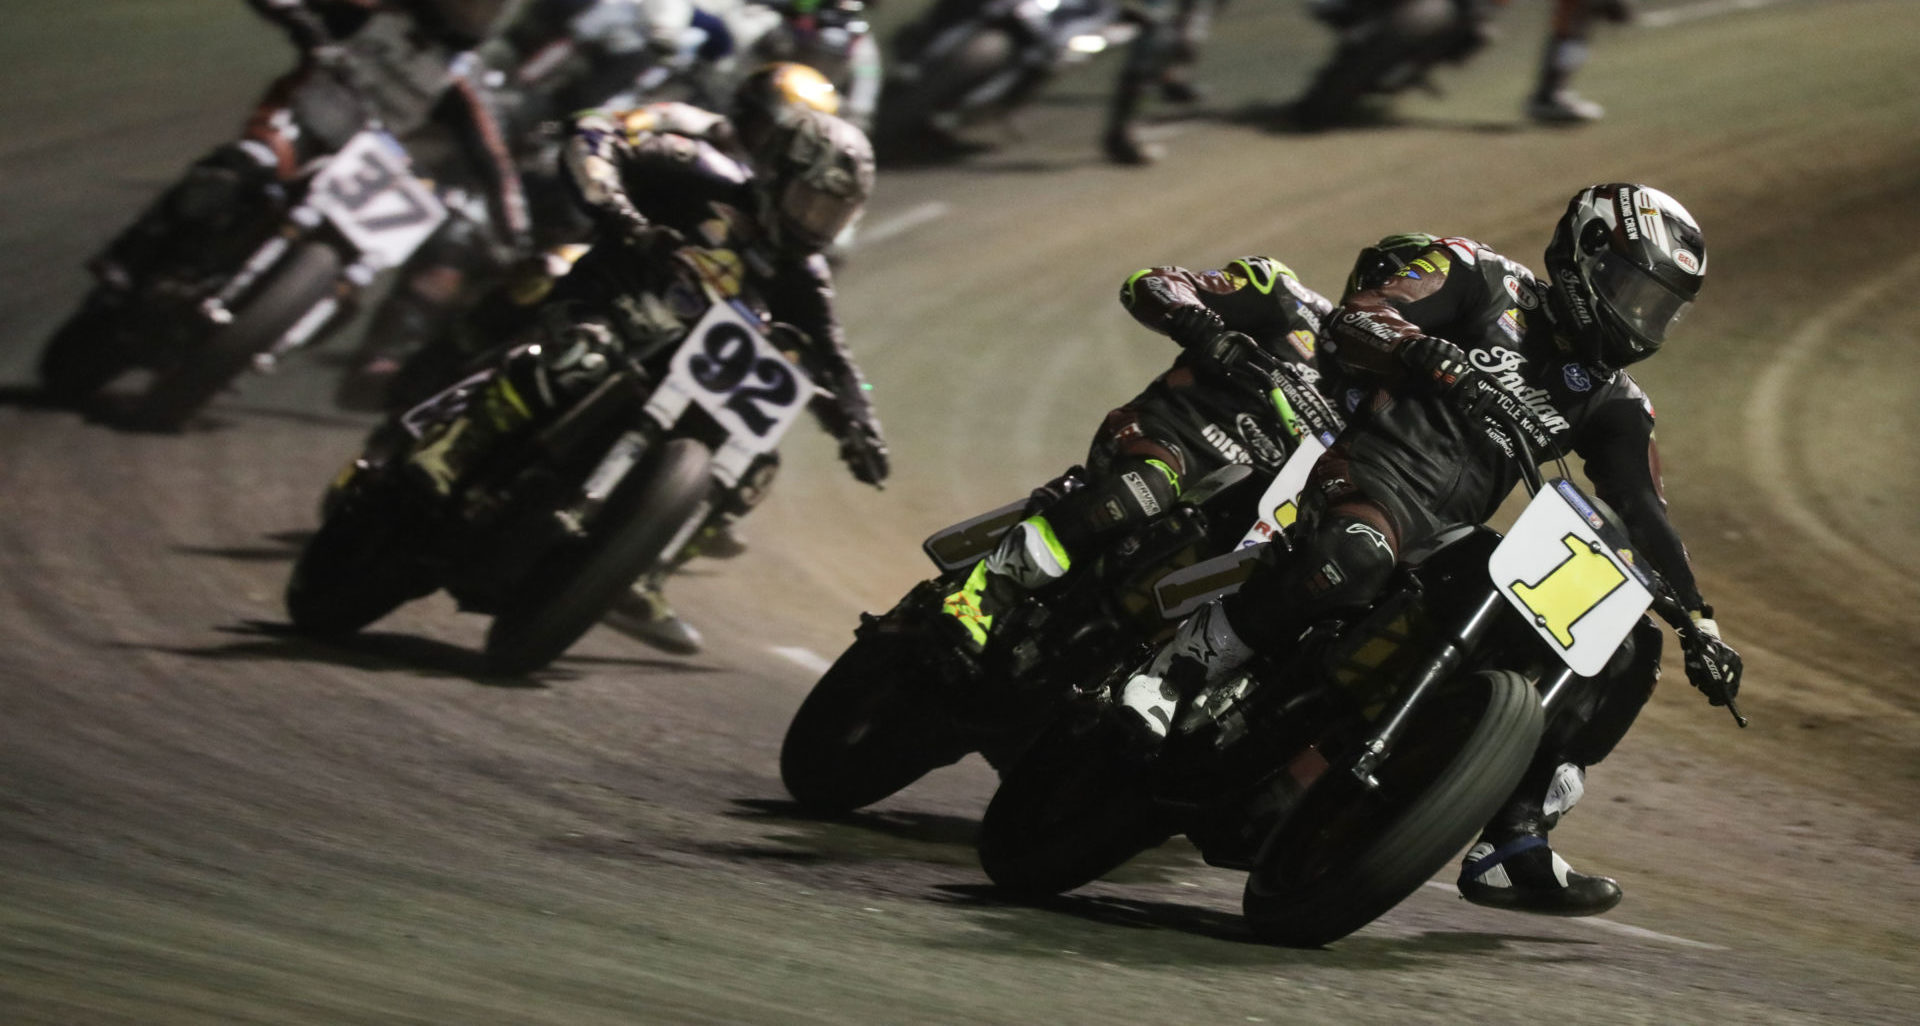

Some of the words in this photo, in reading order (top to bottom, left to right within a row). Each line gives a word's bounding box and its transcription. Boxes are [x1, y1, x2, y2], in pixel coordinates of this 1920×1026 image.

[328, 155, 426, 231] 37
[1624, 215, 1640, 240] CREW
[1678, 252, 1694, 270] BELL
[1509, 281, 1531, 305] BELL
[1560, 268, 1592, 325] Indian
[689, 324, 797, 437] 92
[1271, 369, 1317, 419] MOTORCYCLE
[1468, 345, 1570, 434] Indian
[1509, 532, 1629, 650] 1
